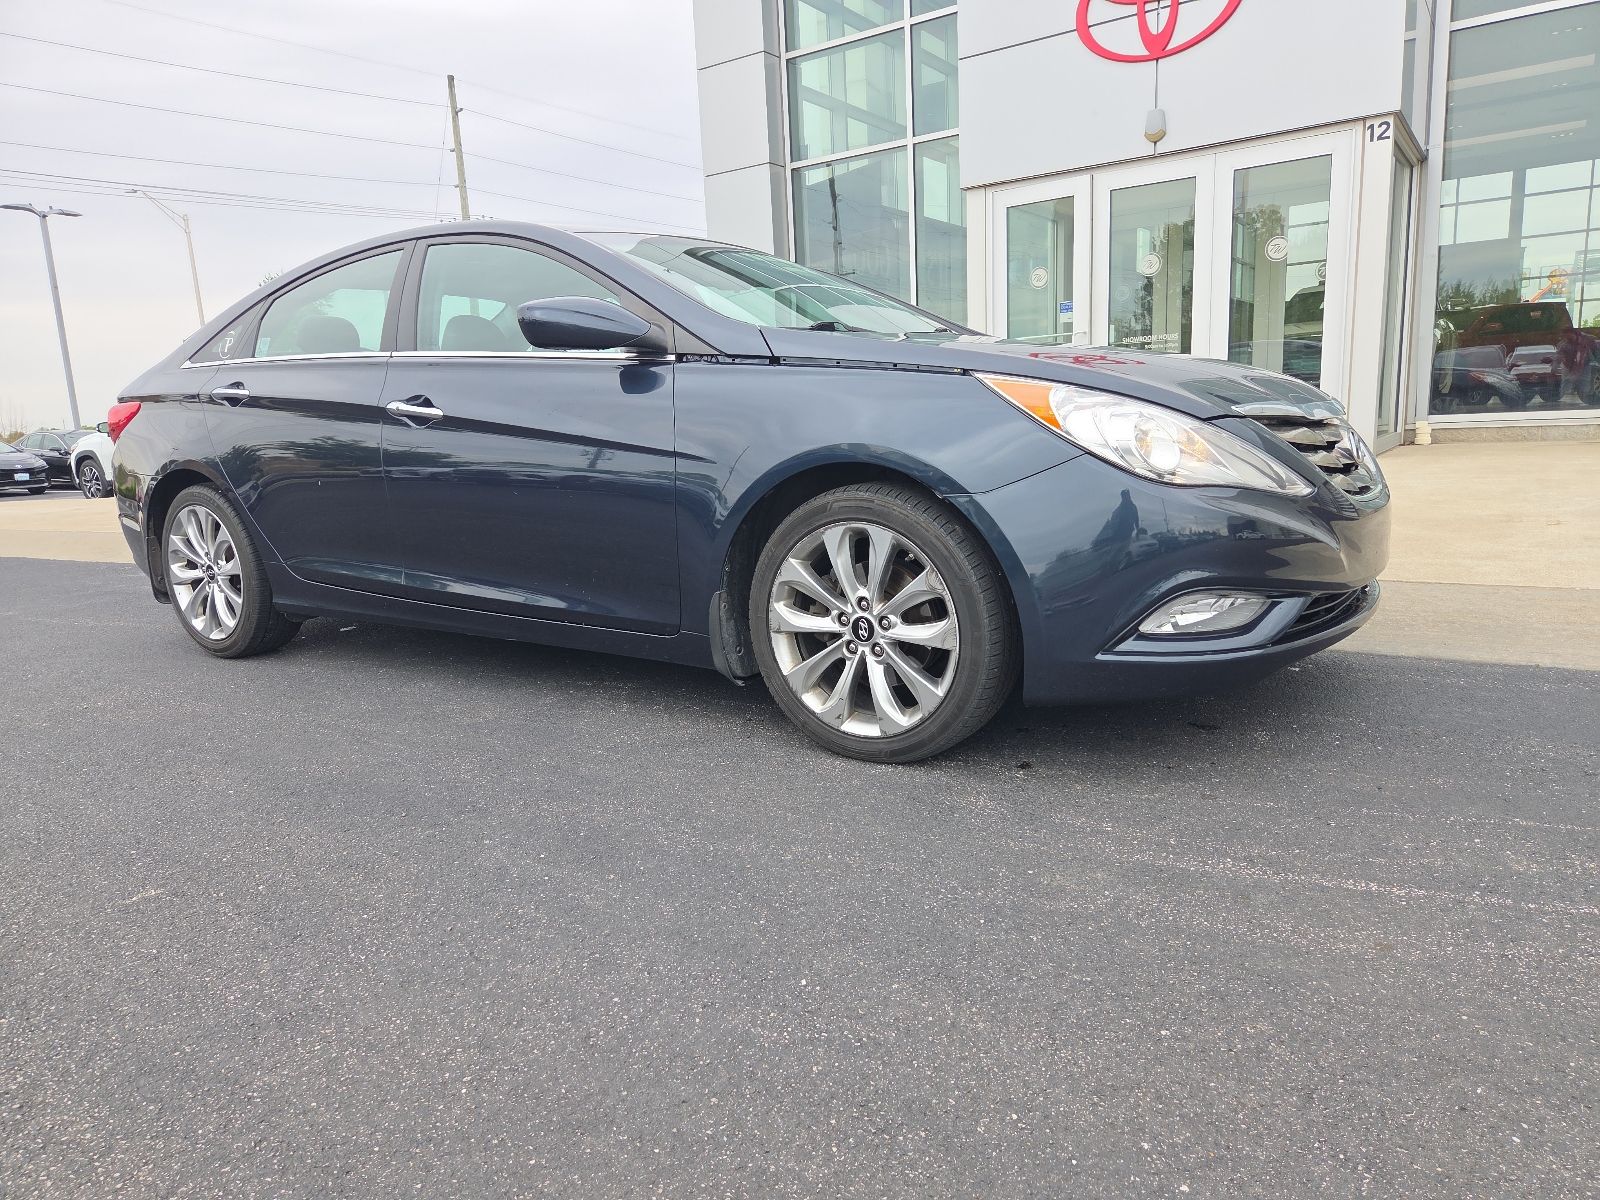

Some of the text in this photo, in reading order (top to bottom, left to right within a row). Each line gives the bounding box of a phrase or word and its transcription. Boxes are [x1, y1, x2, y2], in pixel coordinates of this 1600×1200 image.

[1366, 120, 1391, 143] 12
[1122, 333, 1179, 343] SHOWROOM HOURS
